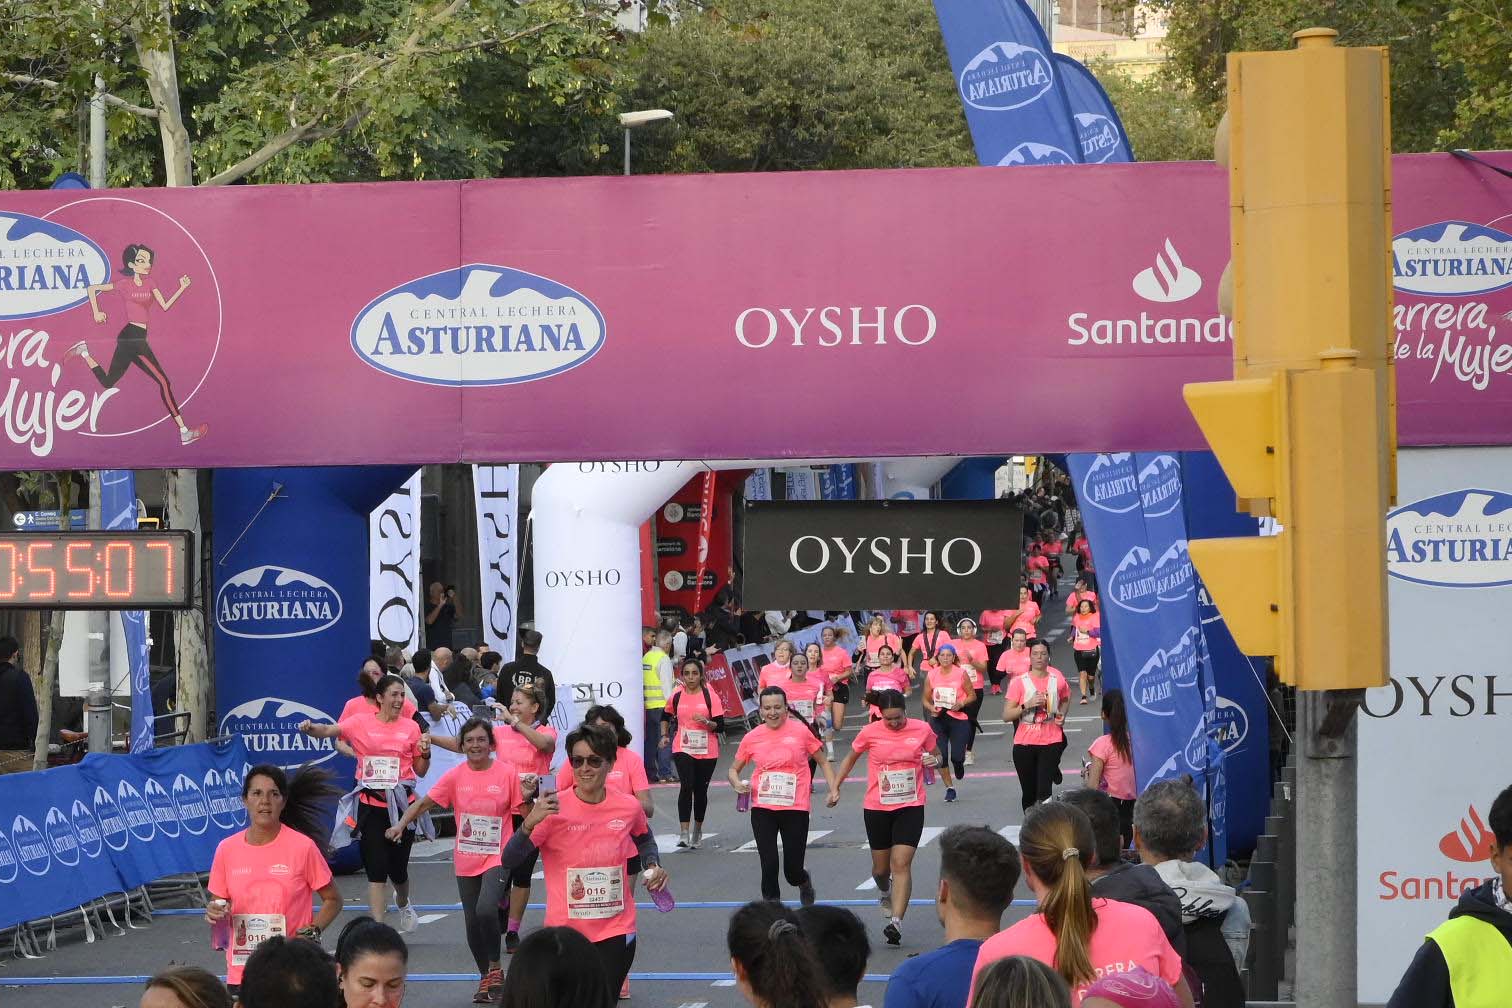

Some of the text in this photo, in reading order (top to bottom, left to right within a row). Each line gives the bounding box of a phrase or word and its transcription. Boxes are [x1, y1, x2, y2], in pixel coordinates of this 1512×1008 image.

[13, 247, 86, 260] LECHERA
[410, 306, 577, 319] CENTRAL LECHERA
[735, 304, 936, 348] OYSHO
[1394, 302, 1488, 331] arrera
[371, 312, 587, 355] ASTURIANA
[1068, 312, 1234, 345] Santand
[1417, 331, 1434, 358] la
[1430, 326, 1512, 391] Muje
[1414, 524, 1481, 534] CENTRAL
[789, 535, 982, 576] OYSHO
[546, 569, 621, 588] OYSHO
[220, 594, 333, 622] ASTURIANA
[576, 682, 623, 700] SHO
[1359, 675, 1512, 718] OYSH
[225, 727, 334, 751] TURIANA
[586, 888, 607, 896] 016
[1379, 871, 1479, 900] Santa
